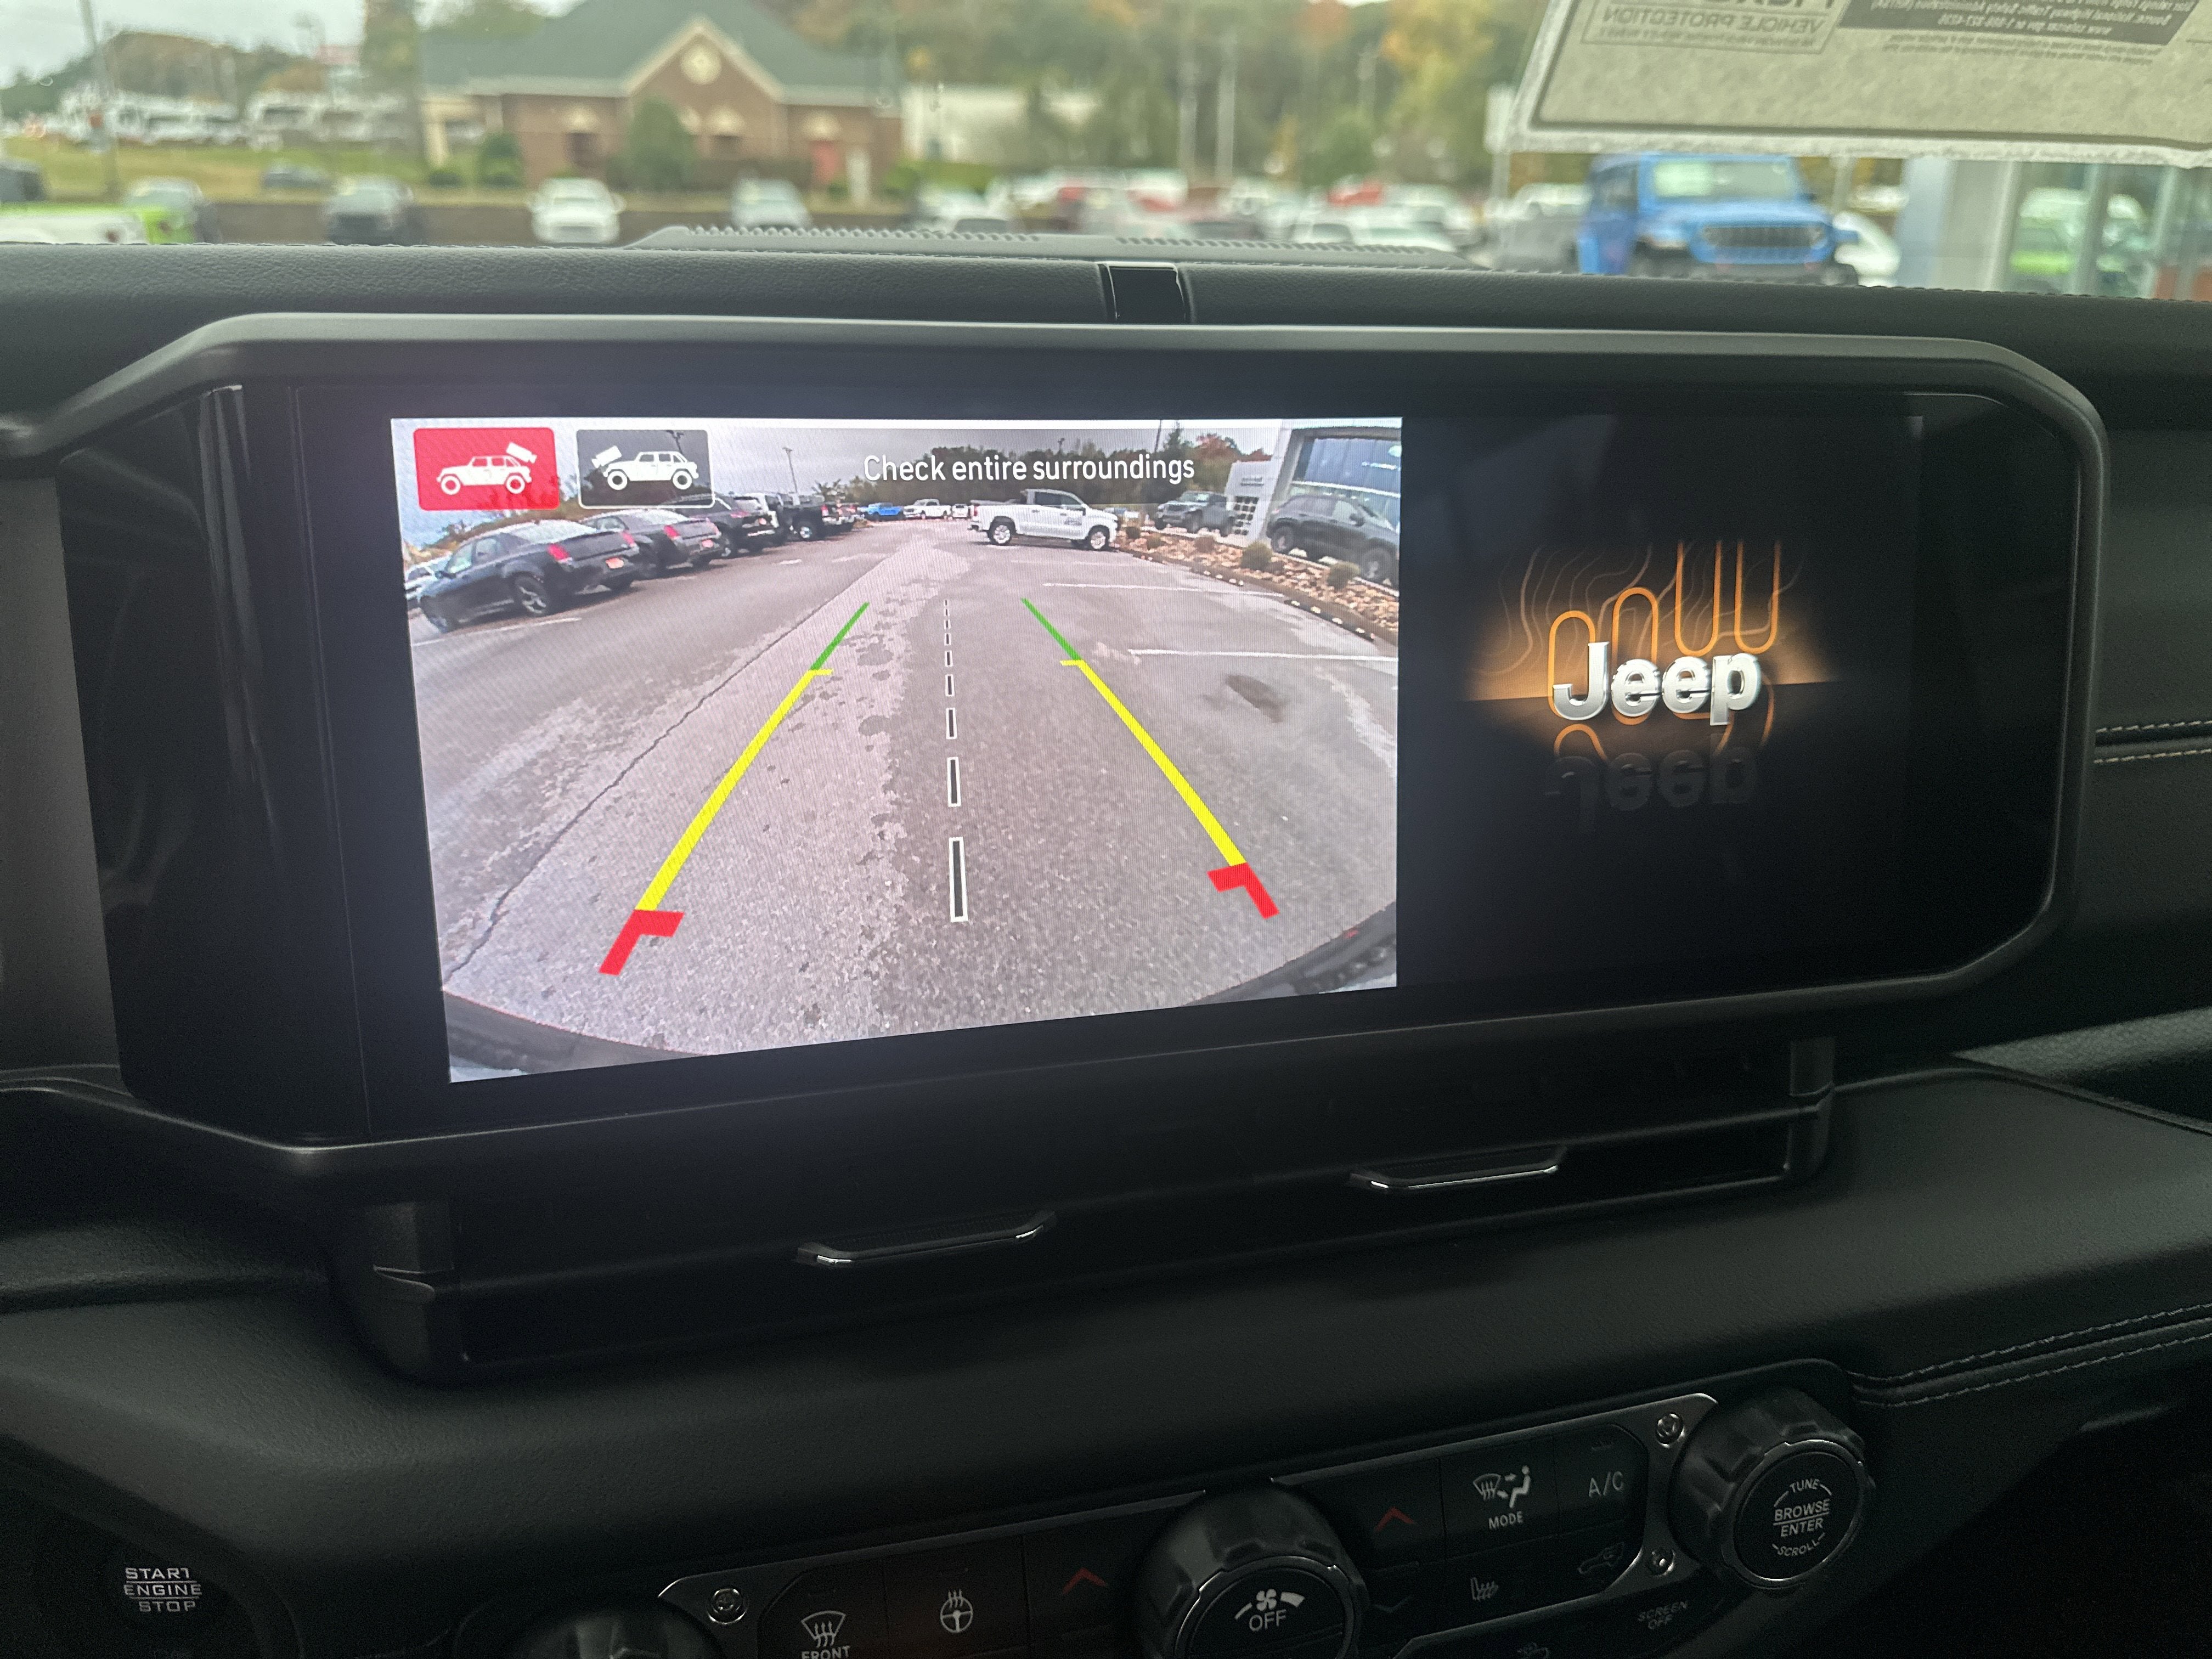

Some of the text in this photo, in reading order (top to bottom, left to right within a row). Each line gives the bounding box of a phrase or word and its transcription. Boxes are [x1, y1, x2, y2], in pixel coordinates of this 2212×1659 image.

[864, 454, 1195, 484] Check entire surroundings
[1553, 641, 1762, 726] Jeep
[1589, 1471, 1622, 1497] A/C
[1790, 1478, 1820, 1493] TUNE
[1774, 1499, 1830, 1521] BROWSE
[1488, 1511, 1523, 1530] MODE
[1781, 1517, 1824, 1537] ENTER
[1777, 1539, 1820, 1556] SCROLL
[126, 1567, 190, 1579] START
[123, 1584, 202, 1596] ENGINE
[139, 1601, 196, 1612] STOP
[1249, 1609, 1286, 1632] OFF
[802, 1645, 850, 1659] FRONT
